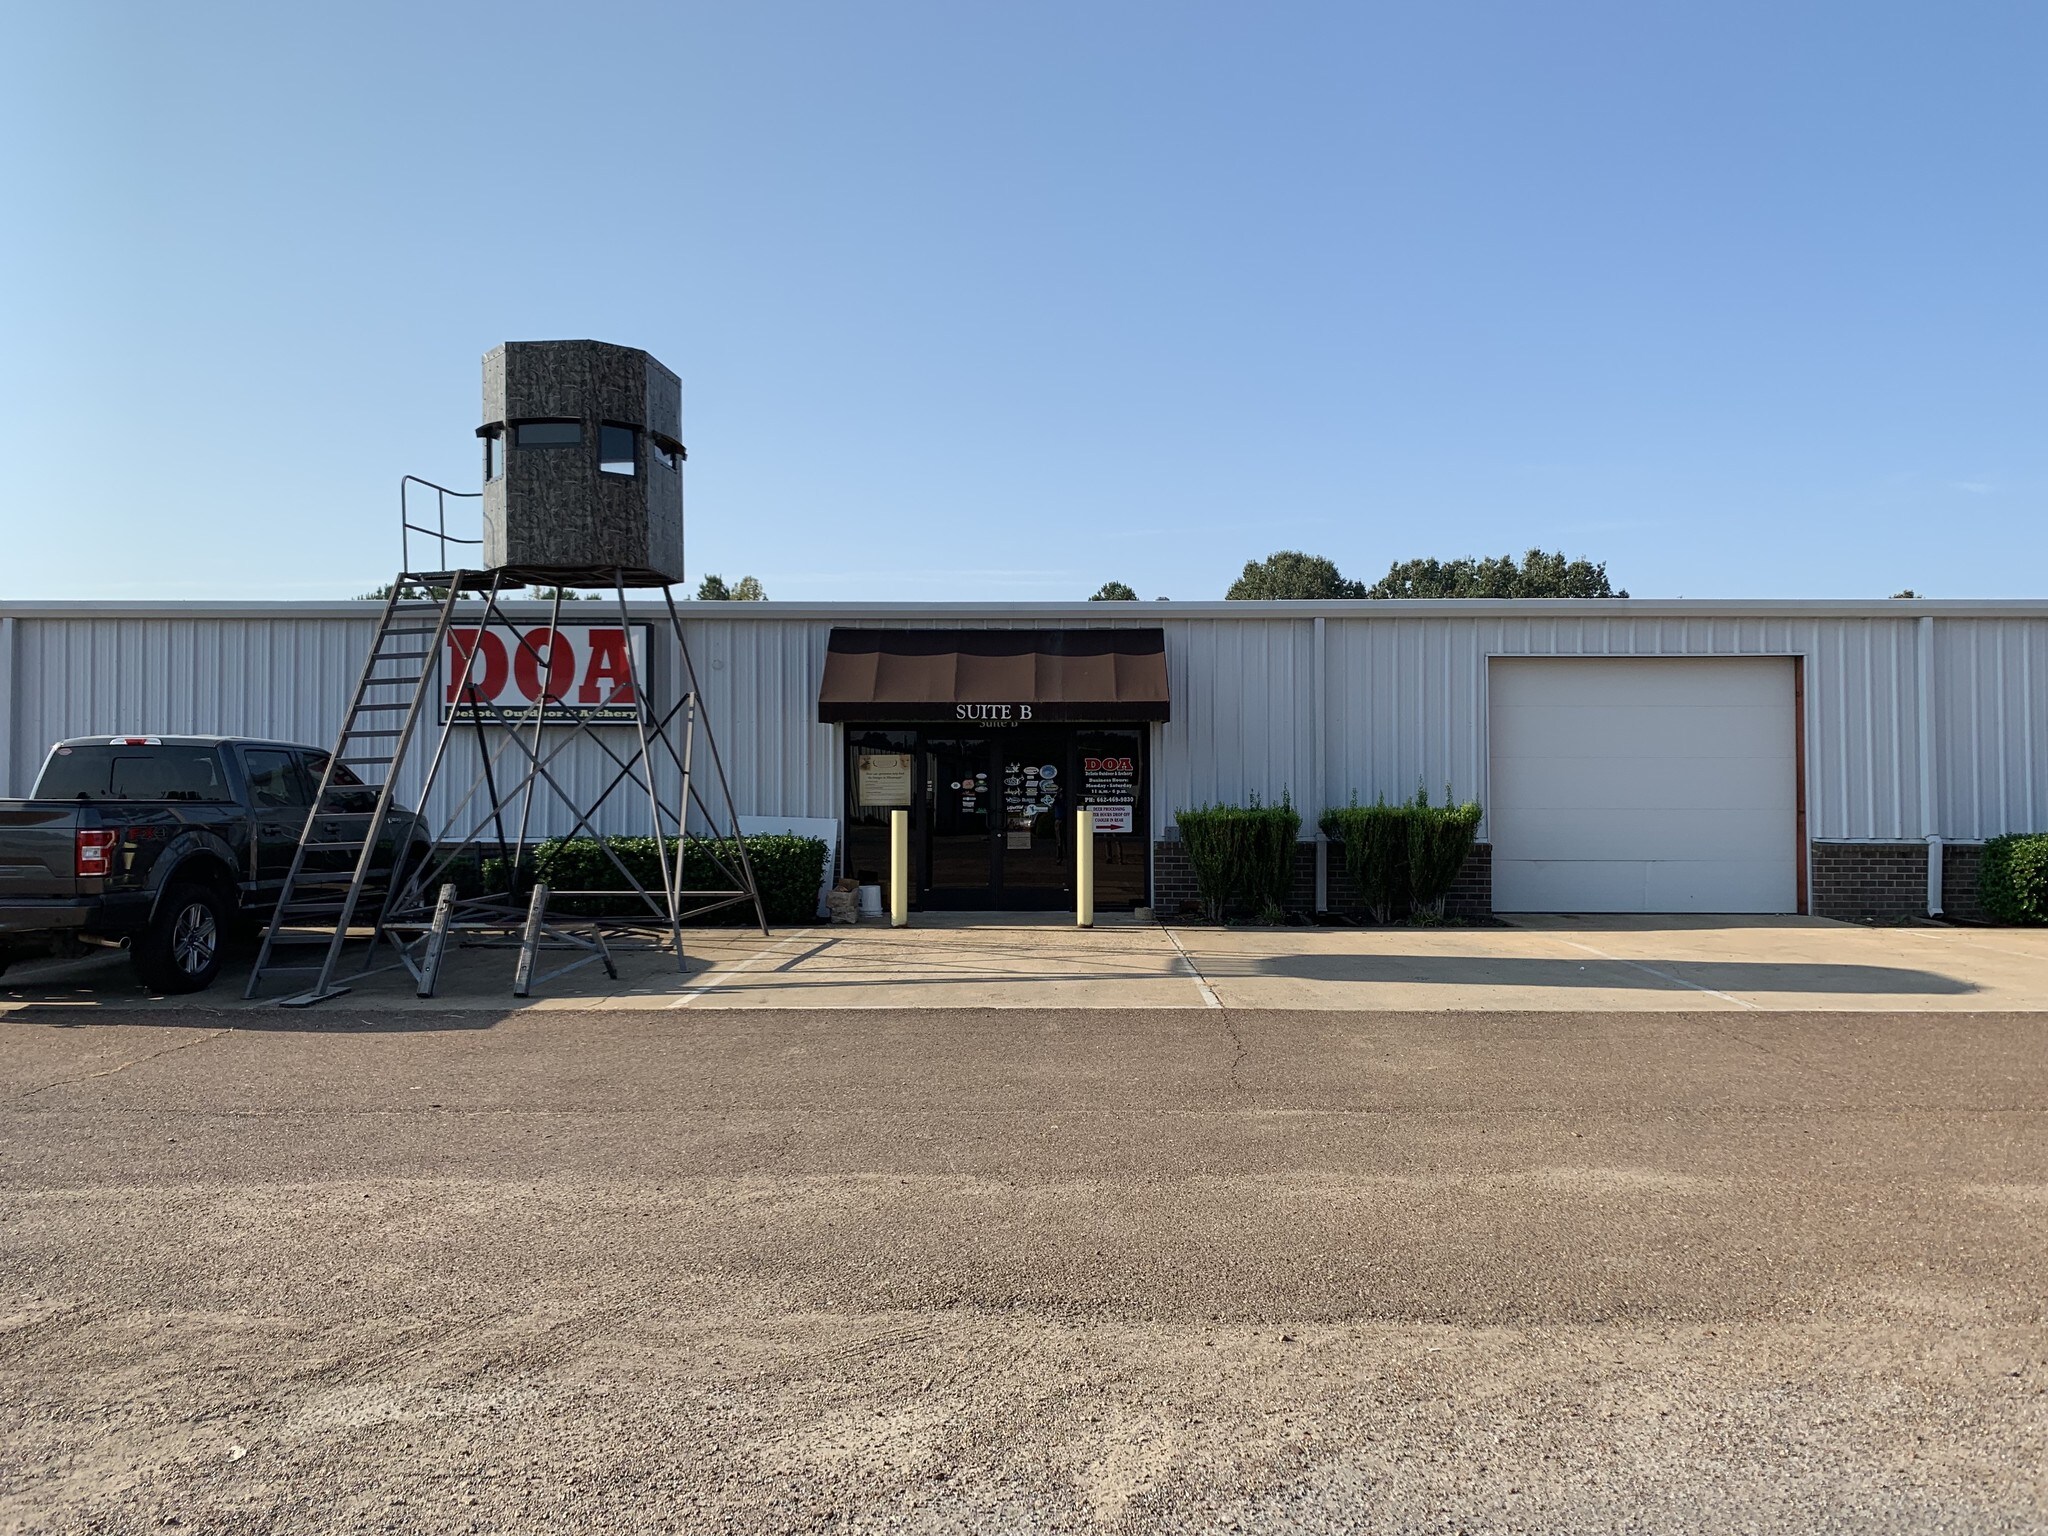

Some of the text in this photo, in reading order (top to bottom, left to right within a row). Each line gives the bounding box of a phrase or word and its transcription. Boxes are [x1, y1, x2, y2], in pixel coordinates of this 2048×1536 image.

[447, 627, 637, 704] DOA
[503, 709, 563, 718] Outdor
[956, 704, 1032, 719] SUITE B
[1084, 757, 1134, 771] DOA
